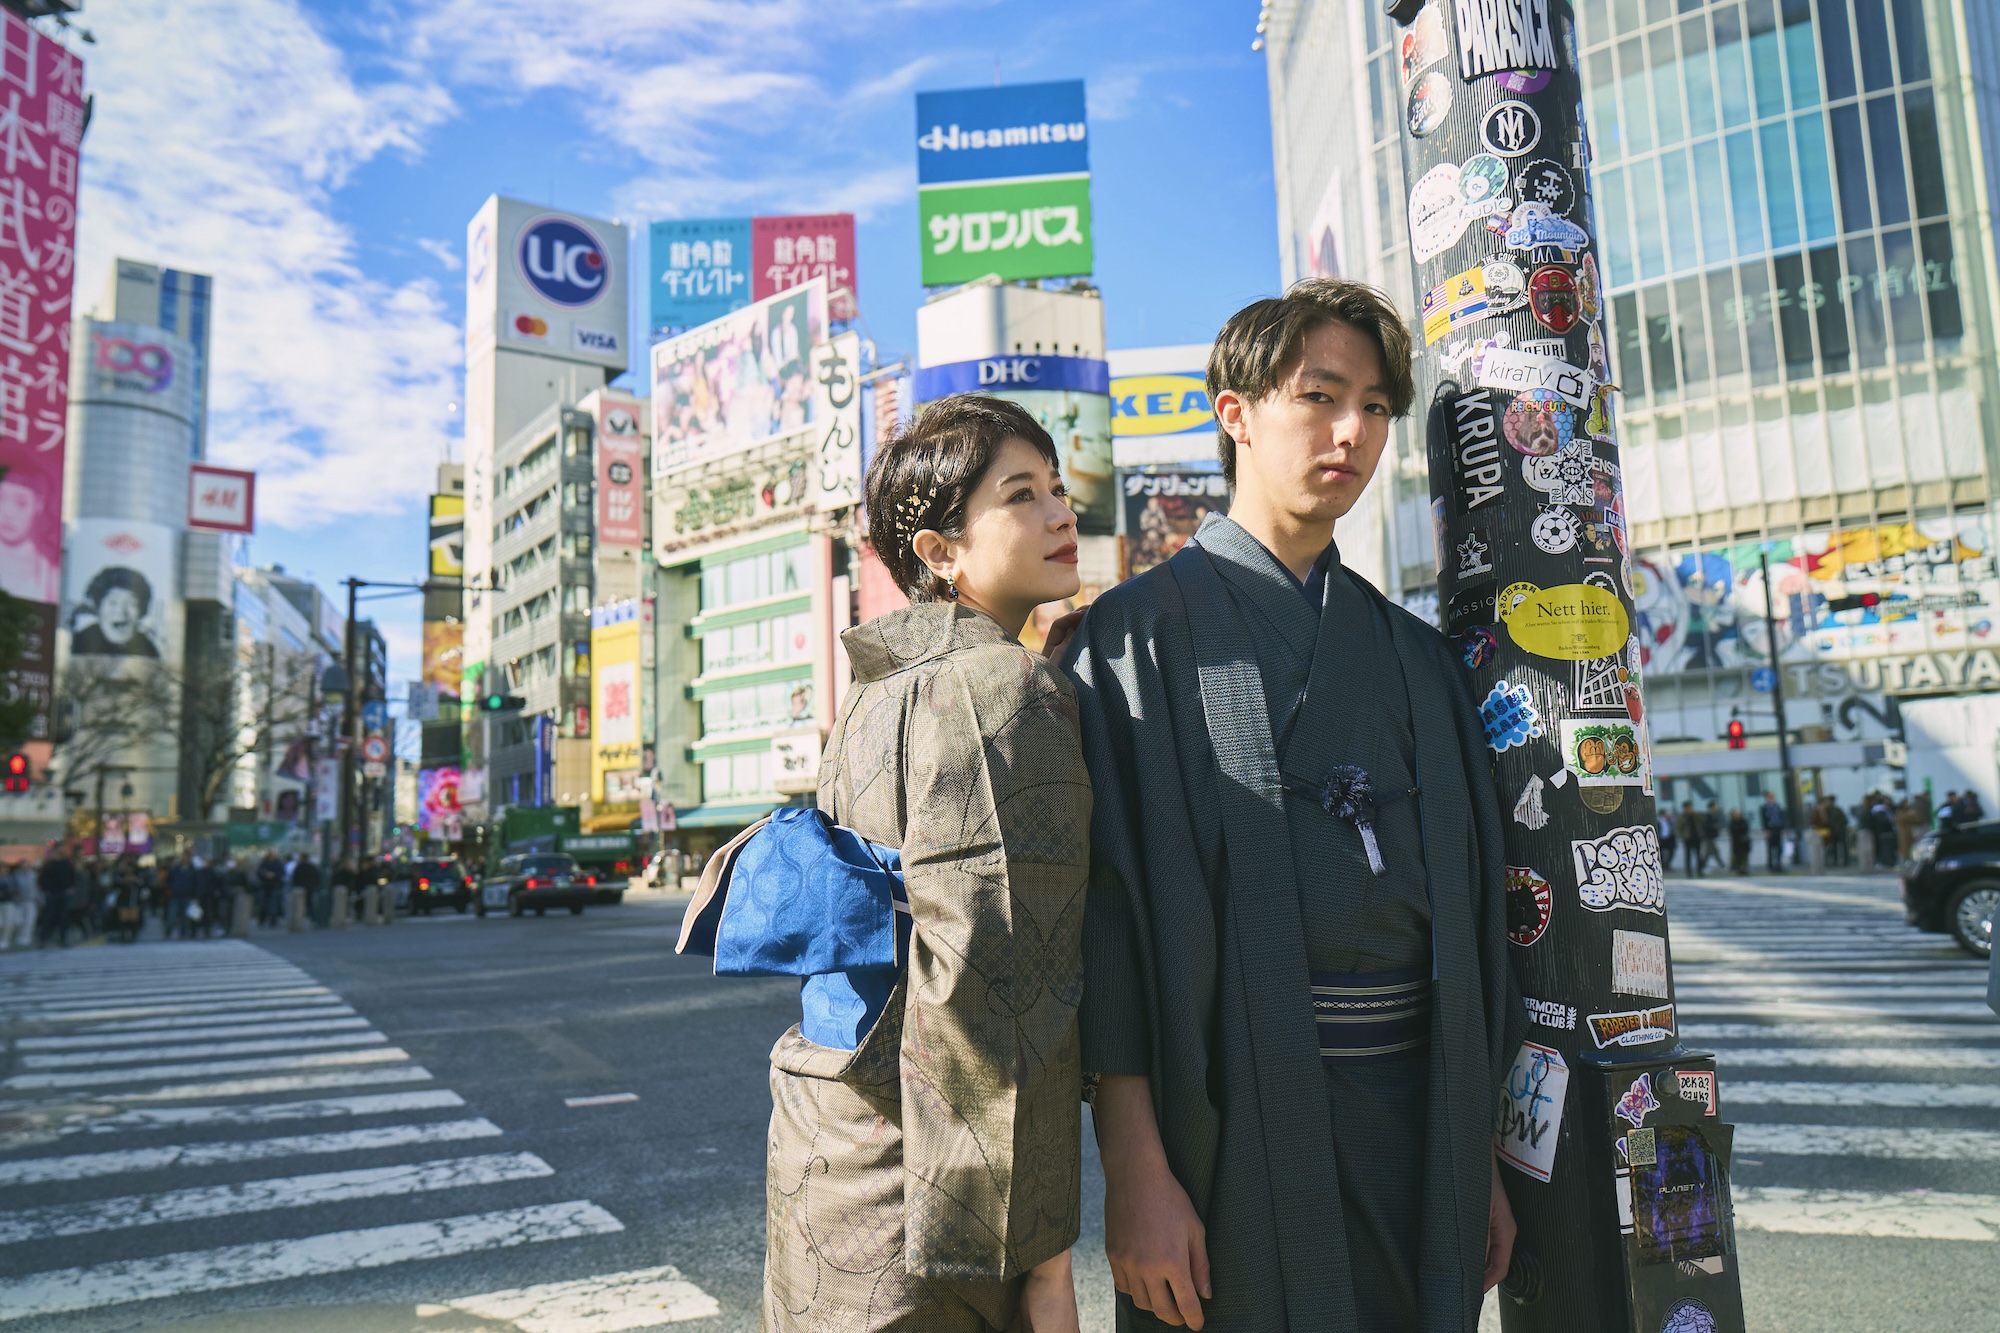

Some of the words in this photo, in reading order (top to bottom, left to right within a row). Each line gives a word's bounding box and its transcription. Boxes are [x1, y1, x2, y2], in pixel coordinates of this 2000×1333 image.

[919, 122, 1086, 152] Hisamitsu
[928, 205, 1083, 254] サロンパス
[1509, 230, 1532, 244] Big
[1535, 227, 1584, 243] Mountain
[35, 50, 82, 452] 水曜日のカンパネラ
[525, 232, 602, 290] UC
[577, 328, 618, 351] VISA
[978, 358, 1041, 385] DHC
[1488, 360, 1553, 386] kiraTV
[1110, 390, 1212, 418] KEA
[1511, 400, 1542, 413] REICHI
[1543, 400, 1567, 413] CUTE
[818, 343, 859, 499] もんじゃ
[1454, 390, 1505, 510] KRUPA
[1554, 504, 1582, 529] MOKI
[1536, 601, 1576, 618] Nett
[1581, 600, 1611, 616] hier.
[1787, 648, 2000, 696] TSUTAYA
[1539, 1012, 1566, 1030] CLUB
[1599, 1015, 1641, 1040] FOREVER
[1621, 1033, 1654, 1043] CLOTHING
[1658, 1183, 1695, 1195] PLANET
